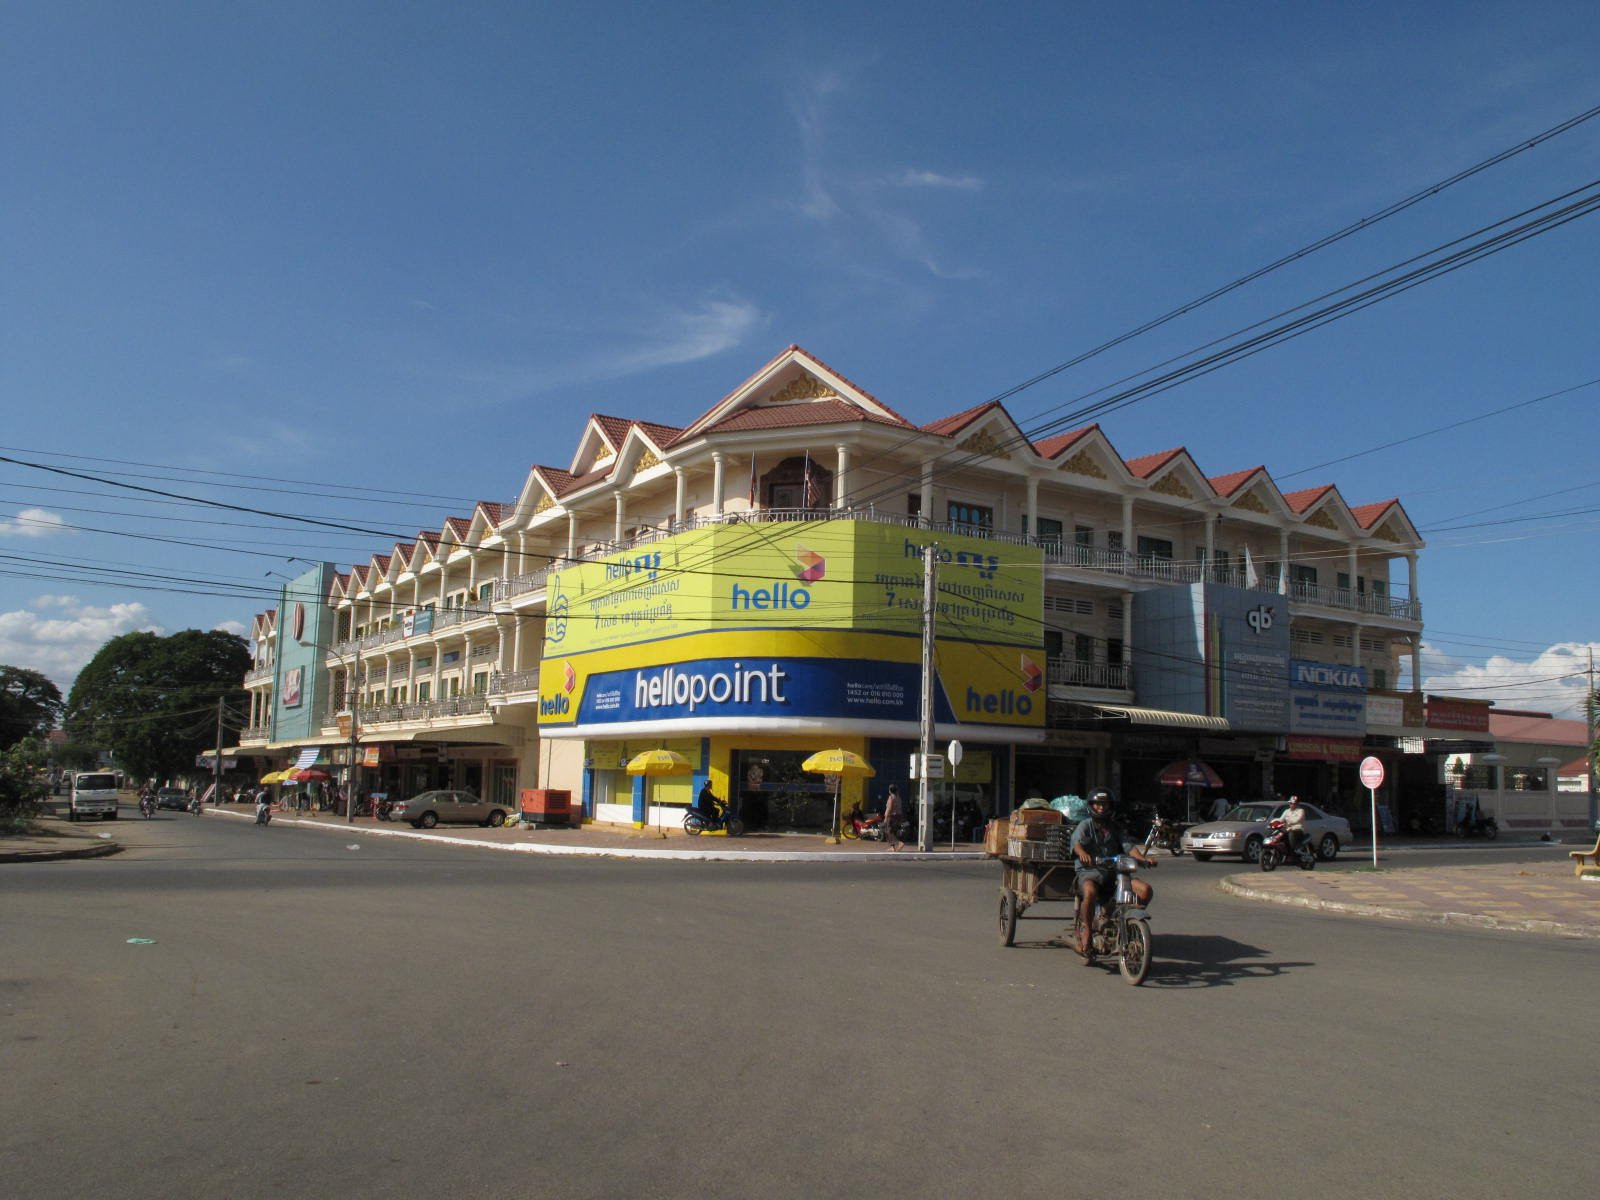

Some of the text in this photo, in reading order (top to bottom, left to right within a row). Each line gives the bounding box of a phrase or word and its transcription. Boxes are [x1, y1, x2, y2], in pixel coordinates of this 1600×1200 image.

[606, 558, 632, 580] hello
[732, 582, 810, 610] hello
[886, 592, 895, 607] 7
[635, 662, 785, 711] hellopoint
[1298, 665, 1363, 688] NOKIA
[541, 693, 569, 716] hello
[966, 686, 1032, 715] hello
